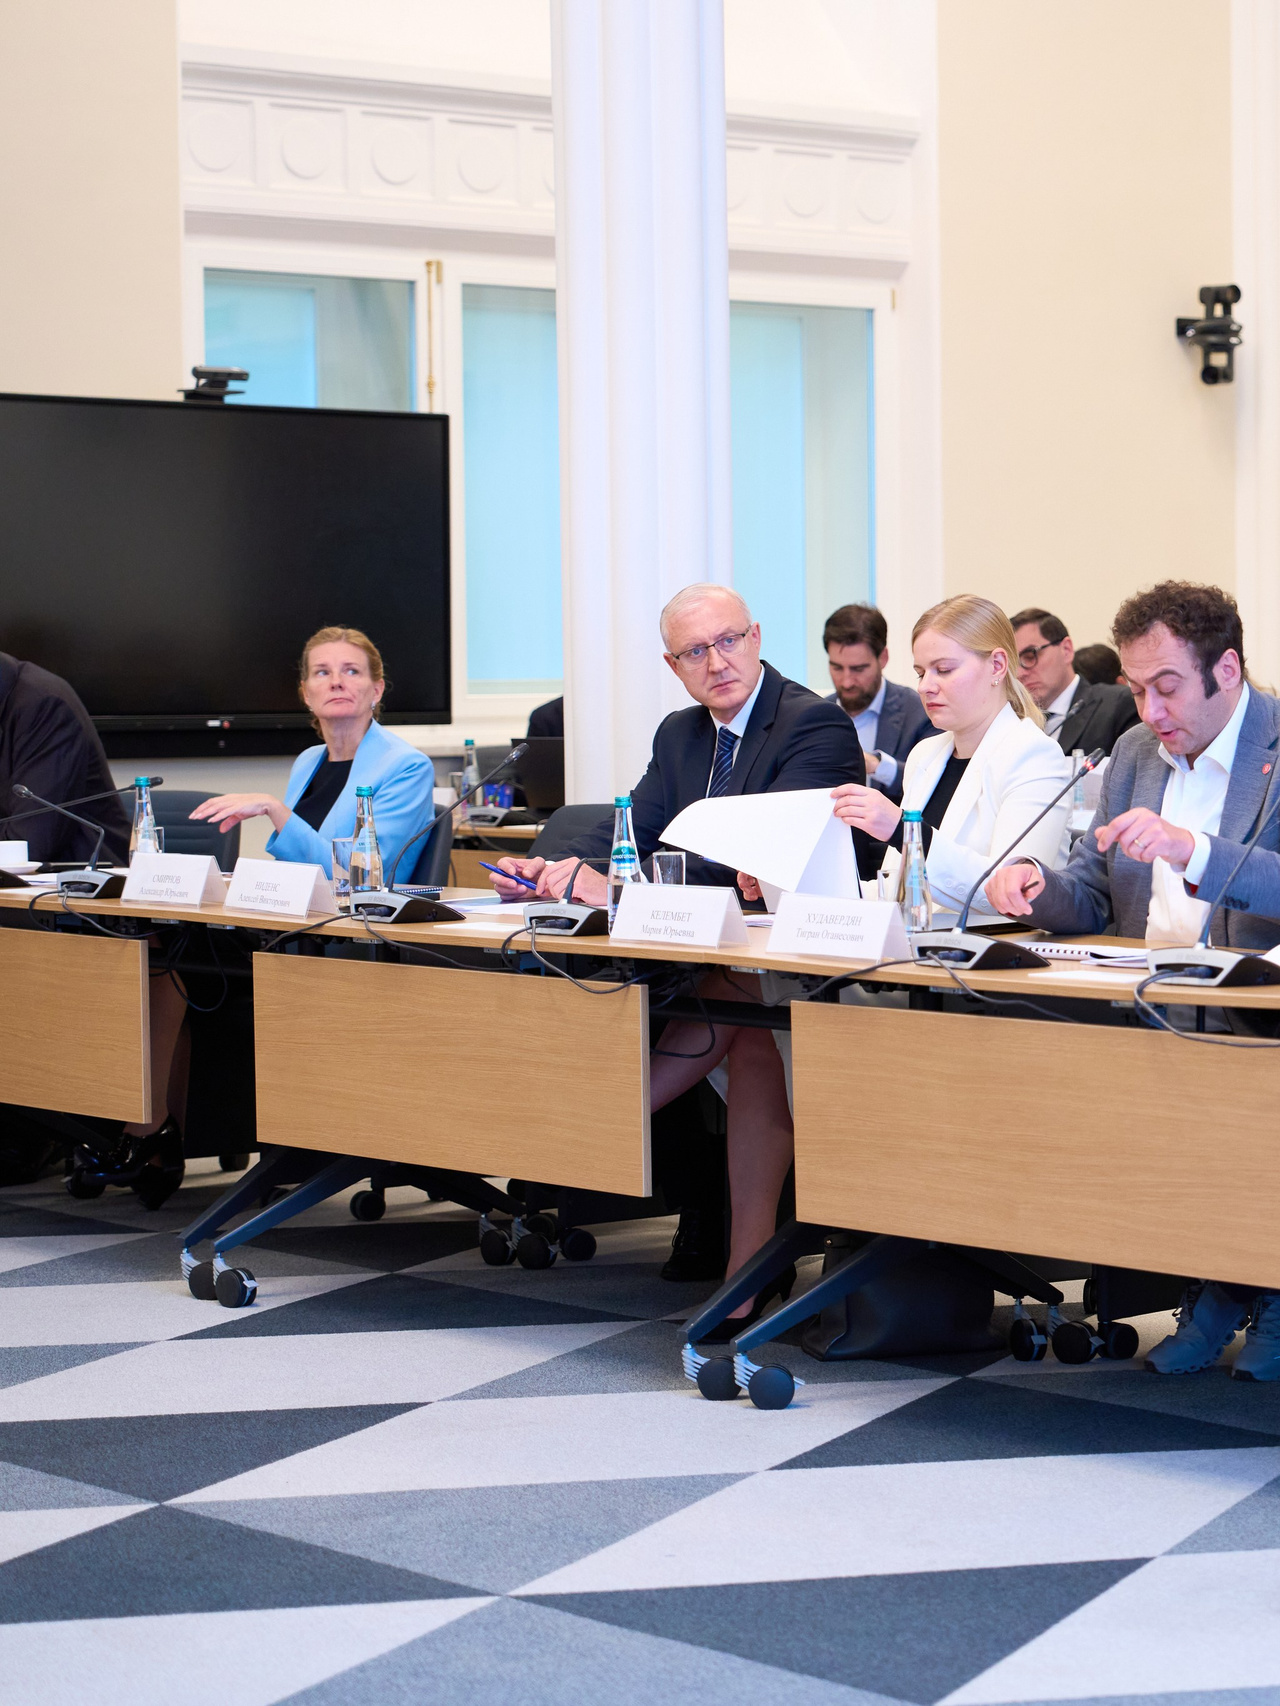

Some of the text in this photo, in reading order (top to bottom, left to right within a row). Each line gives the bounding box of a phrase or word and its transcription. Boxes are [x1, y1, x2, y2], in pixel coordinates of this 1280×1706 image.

[152, 874, 182, 885] СМИРНОВ
[650, 910, 693, 923] КЕЛЕМБЕТ
[805, 913, 863, 927] ХУДАВЕРДЯН
[641, 924, 695, 938] Мария Юрьевна
[796, 928, 865, 943] Тигран Оганесович
